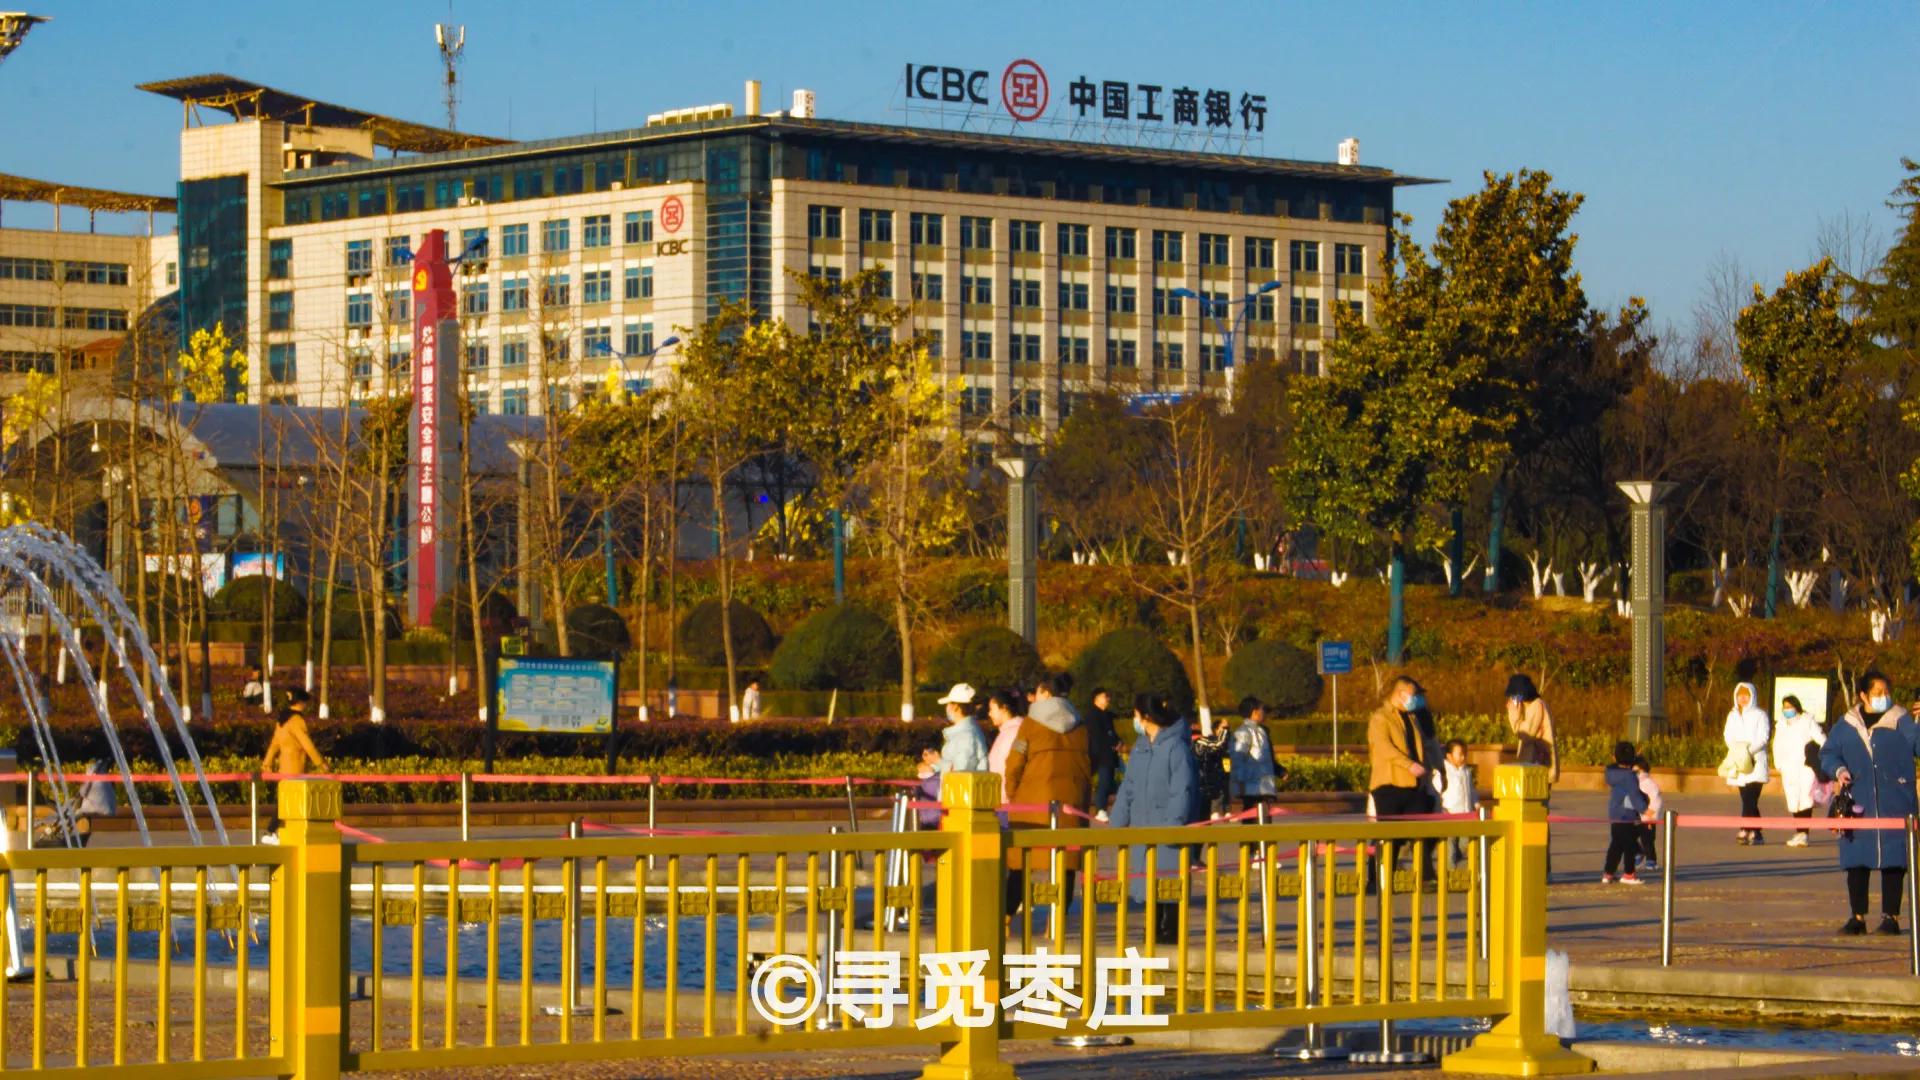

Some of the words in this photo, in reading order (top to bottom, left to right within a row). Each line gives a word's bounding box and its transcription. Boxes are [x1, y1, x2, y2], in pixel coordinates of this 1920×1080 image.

[905, 63, 989, 104] ICBC
[1069, 75, 1268, 132] 中国工商银行
[657, 239, 688, 257] ICBC
